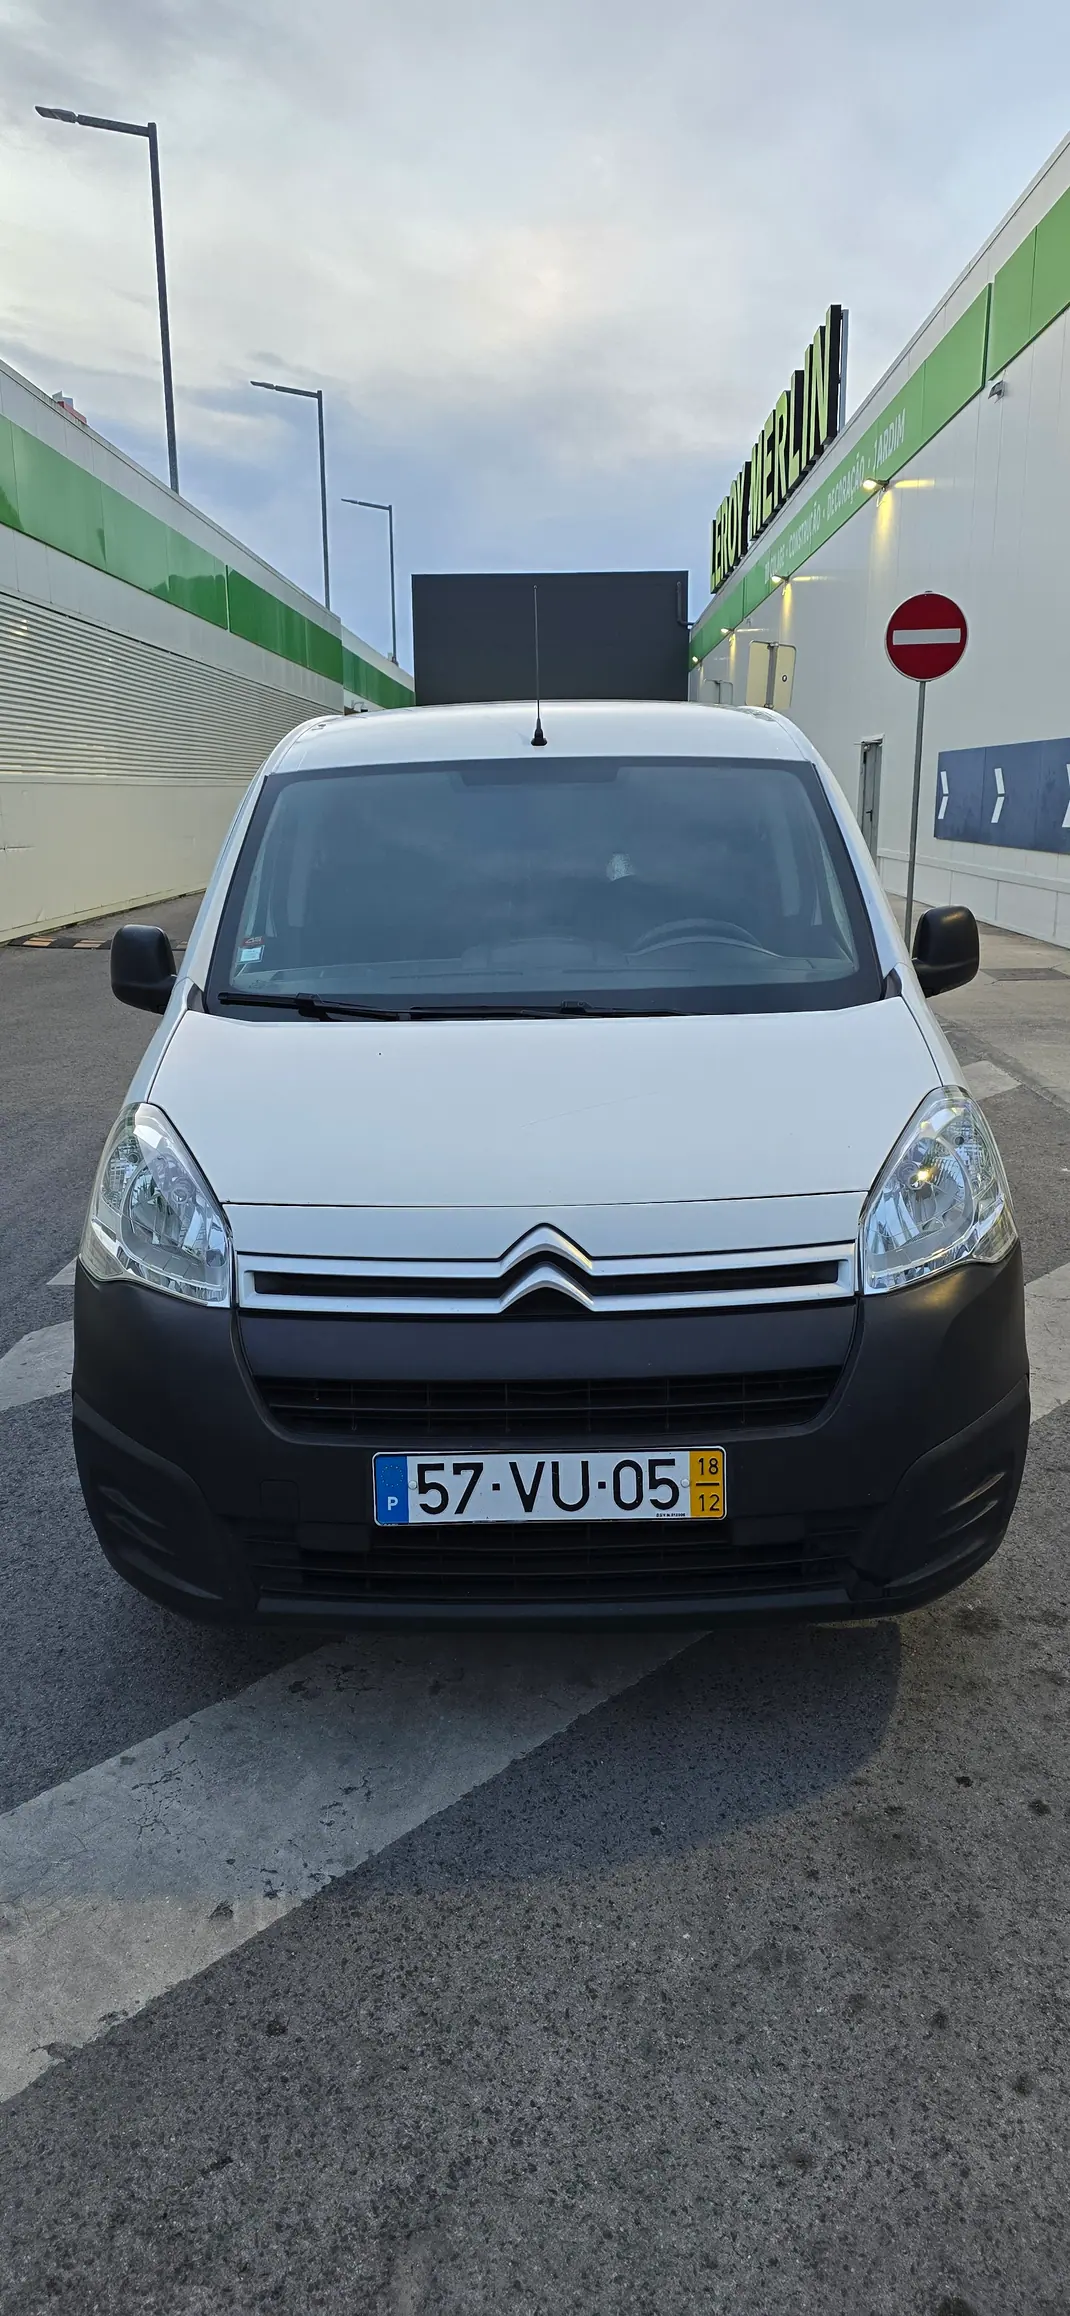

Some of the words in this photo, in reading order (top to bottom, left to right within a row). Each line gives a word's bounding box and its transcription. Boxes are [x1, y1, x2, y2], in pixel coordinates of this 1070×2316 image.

[710, 460, 749, 594] LEROY
[749, 304, 838, 542] MERLIN
[827, 452, 865, 521] DECORAÇÃO
[873, 408, 906, 475] JARDIM
[698, 1457, 719, 1476] 18
[387, 1496, 399, 1511] P
[699, 1494, 720, 1512] 12
